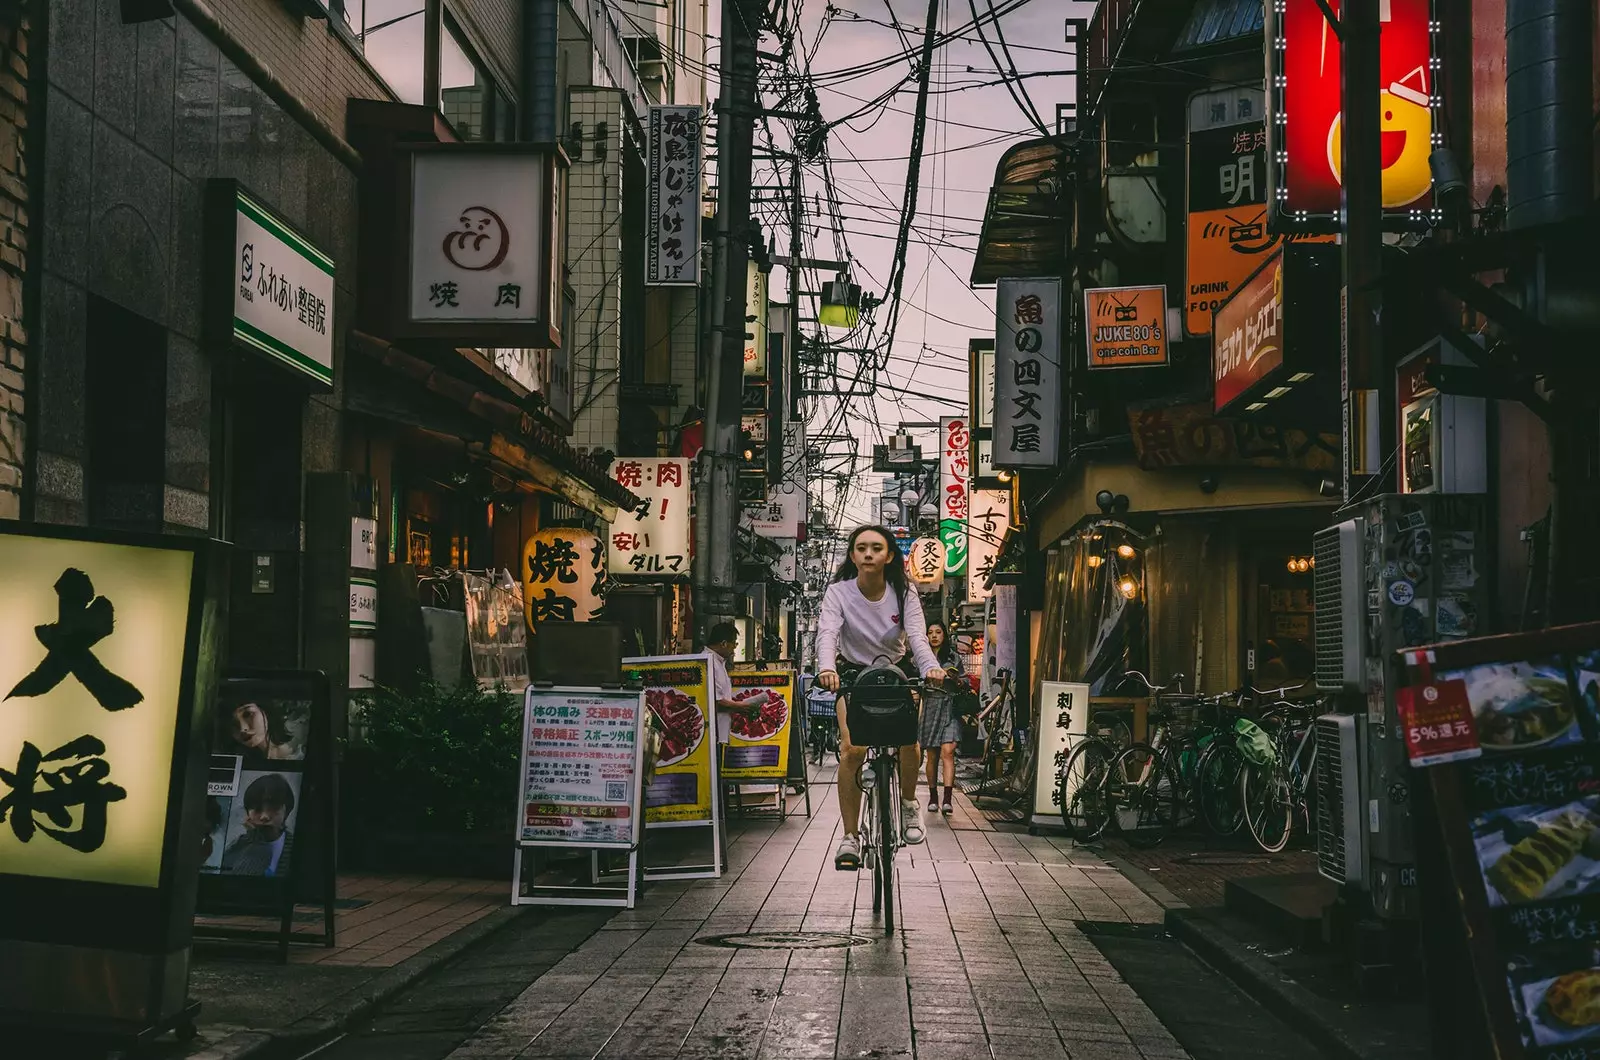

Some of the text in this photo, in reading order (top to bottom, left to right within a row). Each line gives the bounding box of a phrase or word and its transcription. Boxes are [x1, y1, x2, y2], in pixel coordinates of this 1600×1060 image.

[664, 264, 683, 279] 1F
[1190, 280, 1230, 296] DRINK
[256, 262, 327, 336] ふれあい整骨院
[1190, 300, 1223, 313] FOO
[1097, 343, 1161, 357] one coin Bar
[1215, 326, 1243, 382] カラオケ
[1009, 293, 1044, 453] 魚の四文屋
[766, 502, 784, 522] 恵
[612, 531, 651, 552] 安い
[944, 522, 968, 573] すし
[628, 553, 684, 573] ダルマ
[528, 537, 580, 622] 焼肉
[0, 566, 145, 854] 大将
[533, 705, 634, 719] 体の痛み 交通事故
[532, 727, 634, 742] 骨格矯正 スポーツ外傷
[1409, 720, 1470, 743] 5%還元
[208, 783, 233, 792] ROWN
